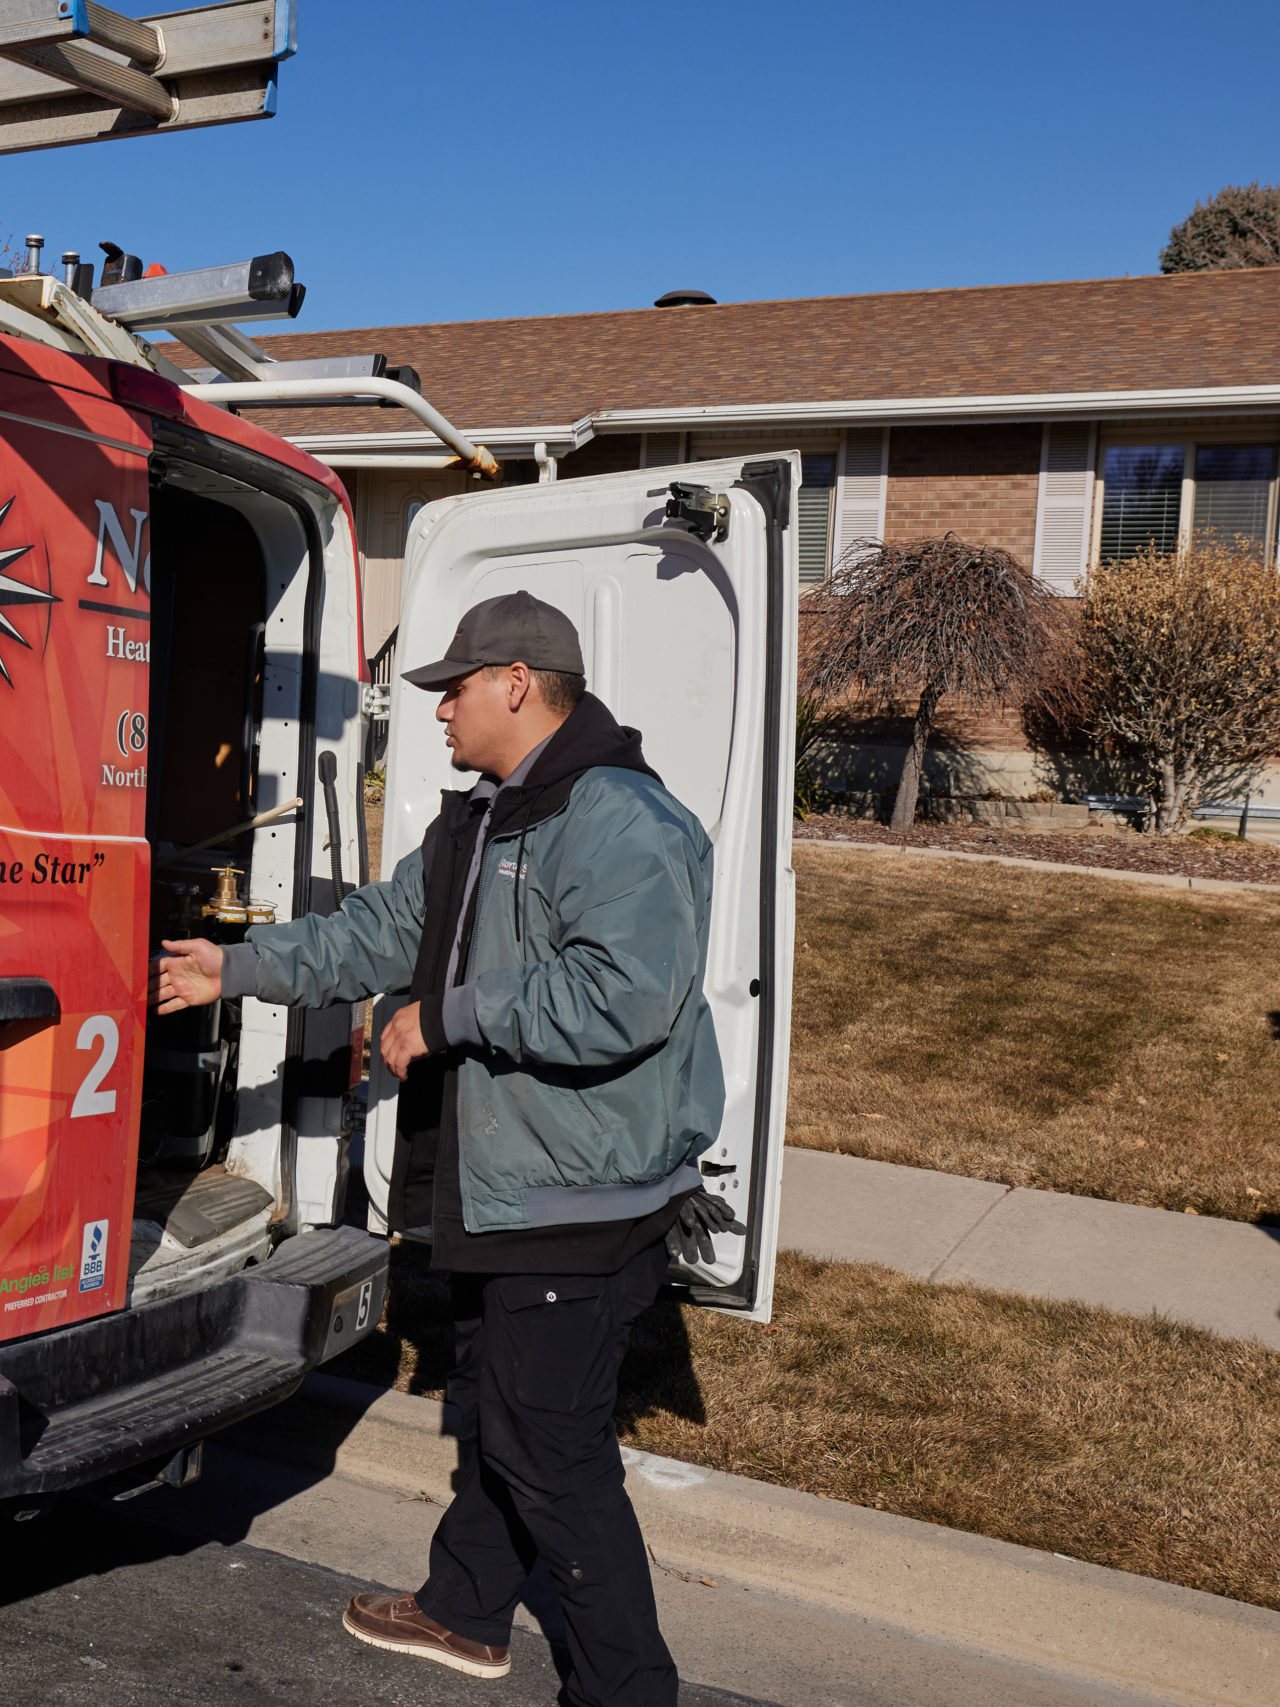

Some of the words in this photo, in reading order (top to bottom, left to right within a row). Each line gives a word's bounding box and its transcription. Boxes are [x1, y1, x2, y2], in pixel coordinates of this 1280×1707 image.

[87, 499, 150, 594] N
[117, 709, 147, 757] (8
[70, 1015, 119, 1118] 2
[53, 1263, 74, 1282] list
[84, 1260, 102, 1275] BBB
[4, 1297, 34, 1312] PREFERRED
[35, 1290, 67, 1304] CONTRACTOR
[358, 1284, 370, 1327] 5
